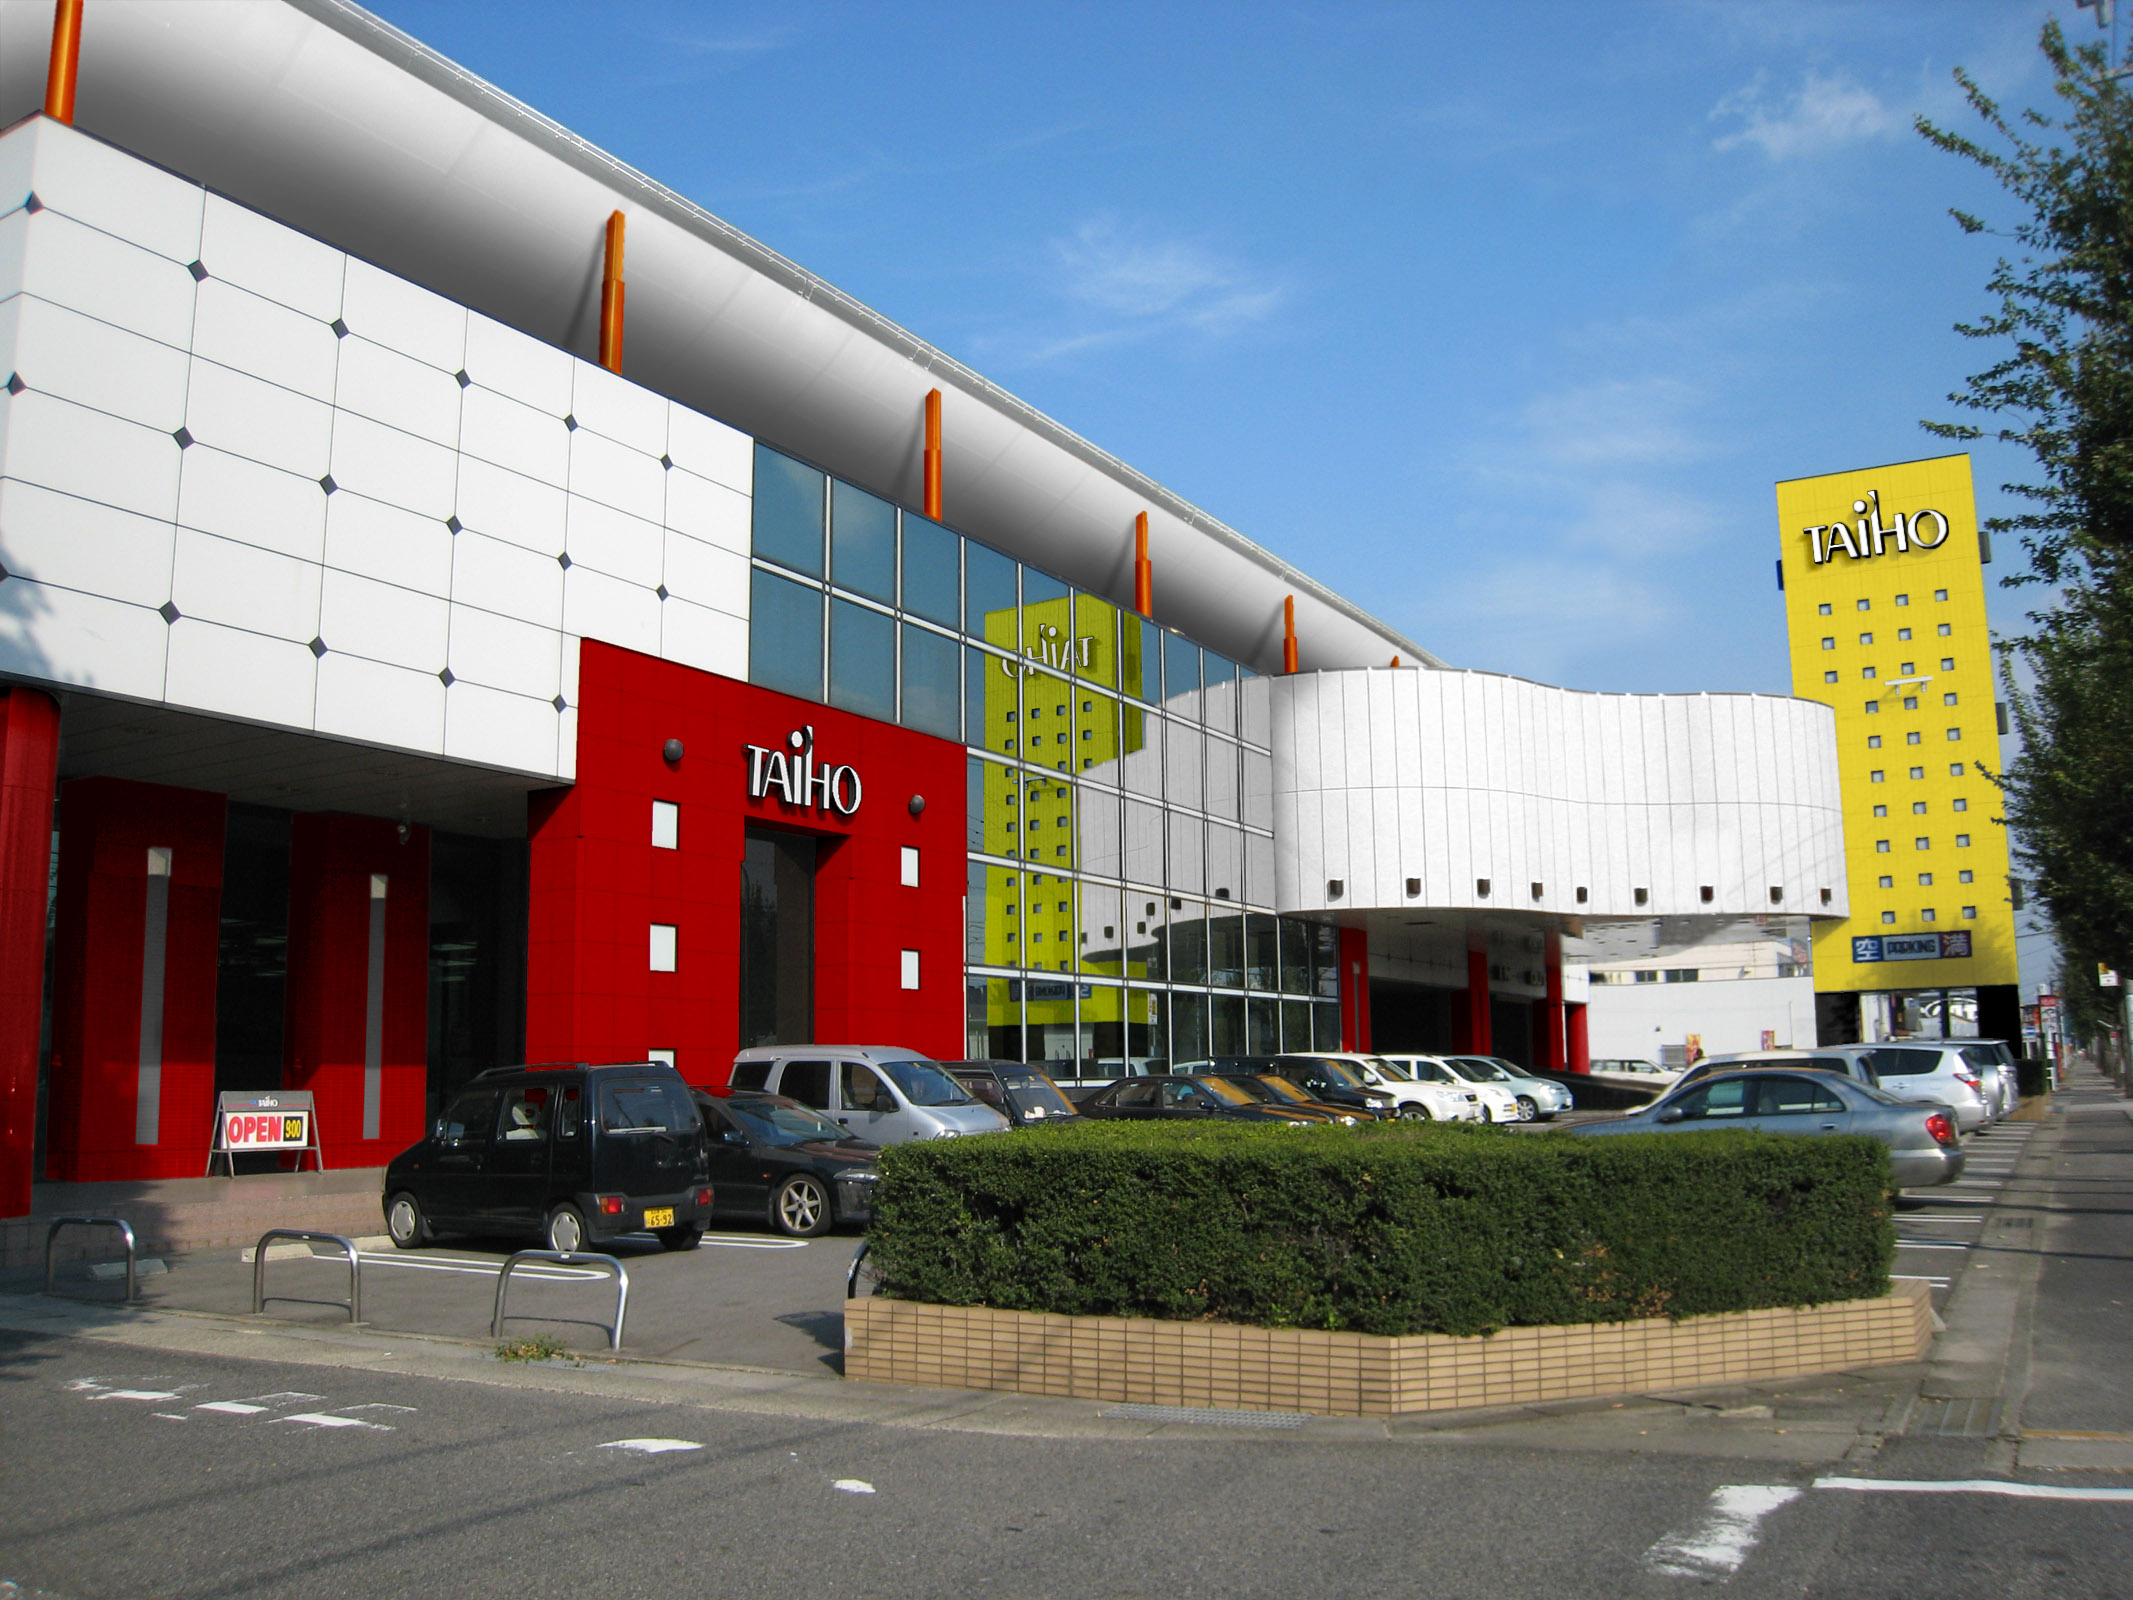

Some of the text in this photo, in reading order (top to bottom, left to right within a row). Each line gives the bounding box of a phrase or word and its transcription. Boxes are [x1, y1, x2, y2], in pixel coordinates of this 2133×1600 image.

[1855, 933, 1969, 961] 空 PARKING 満
[228, 1115, 282, 1143] OPEN
